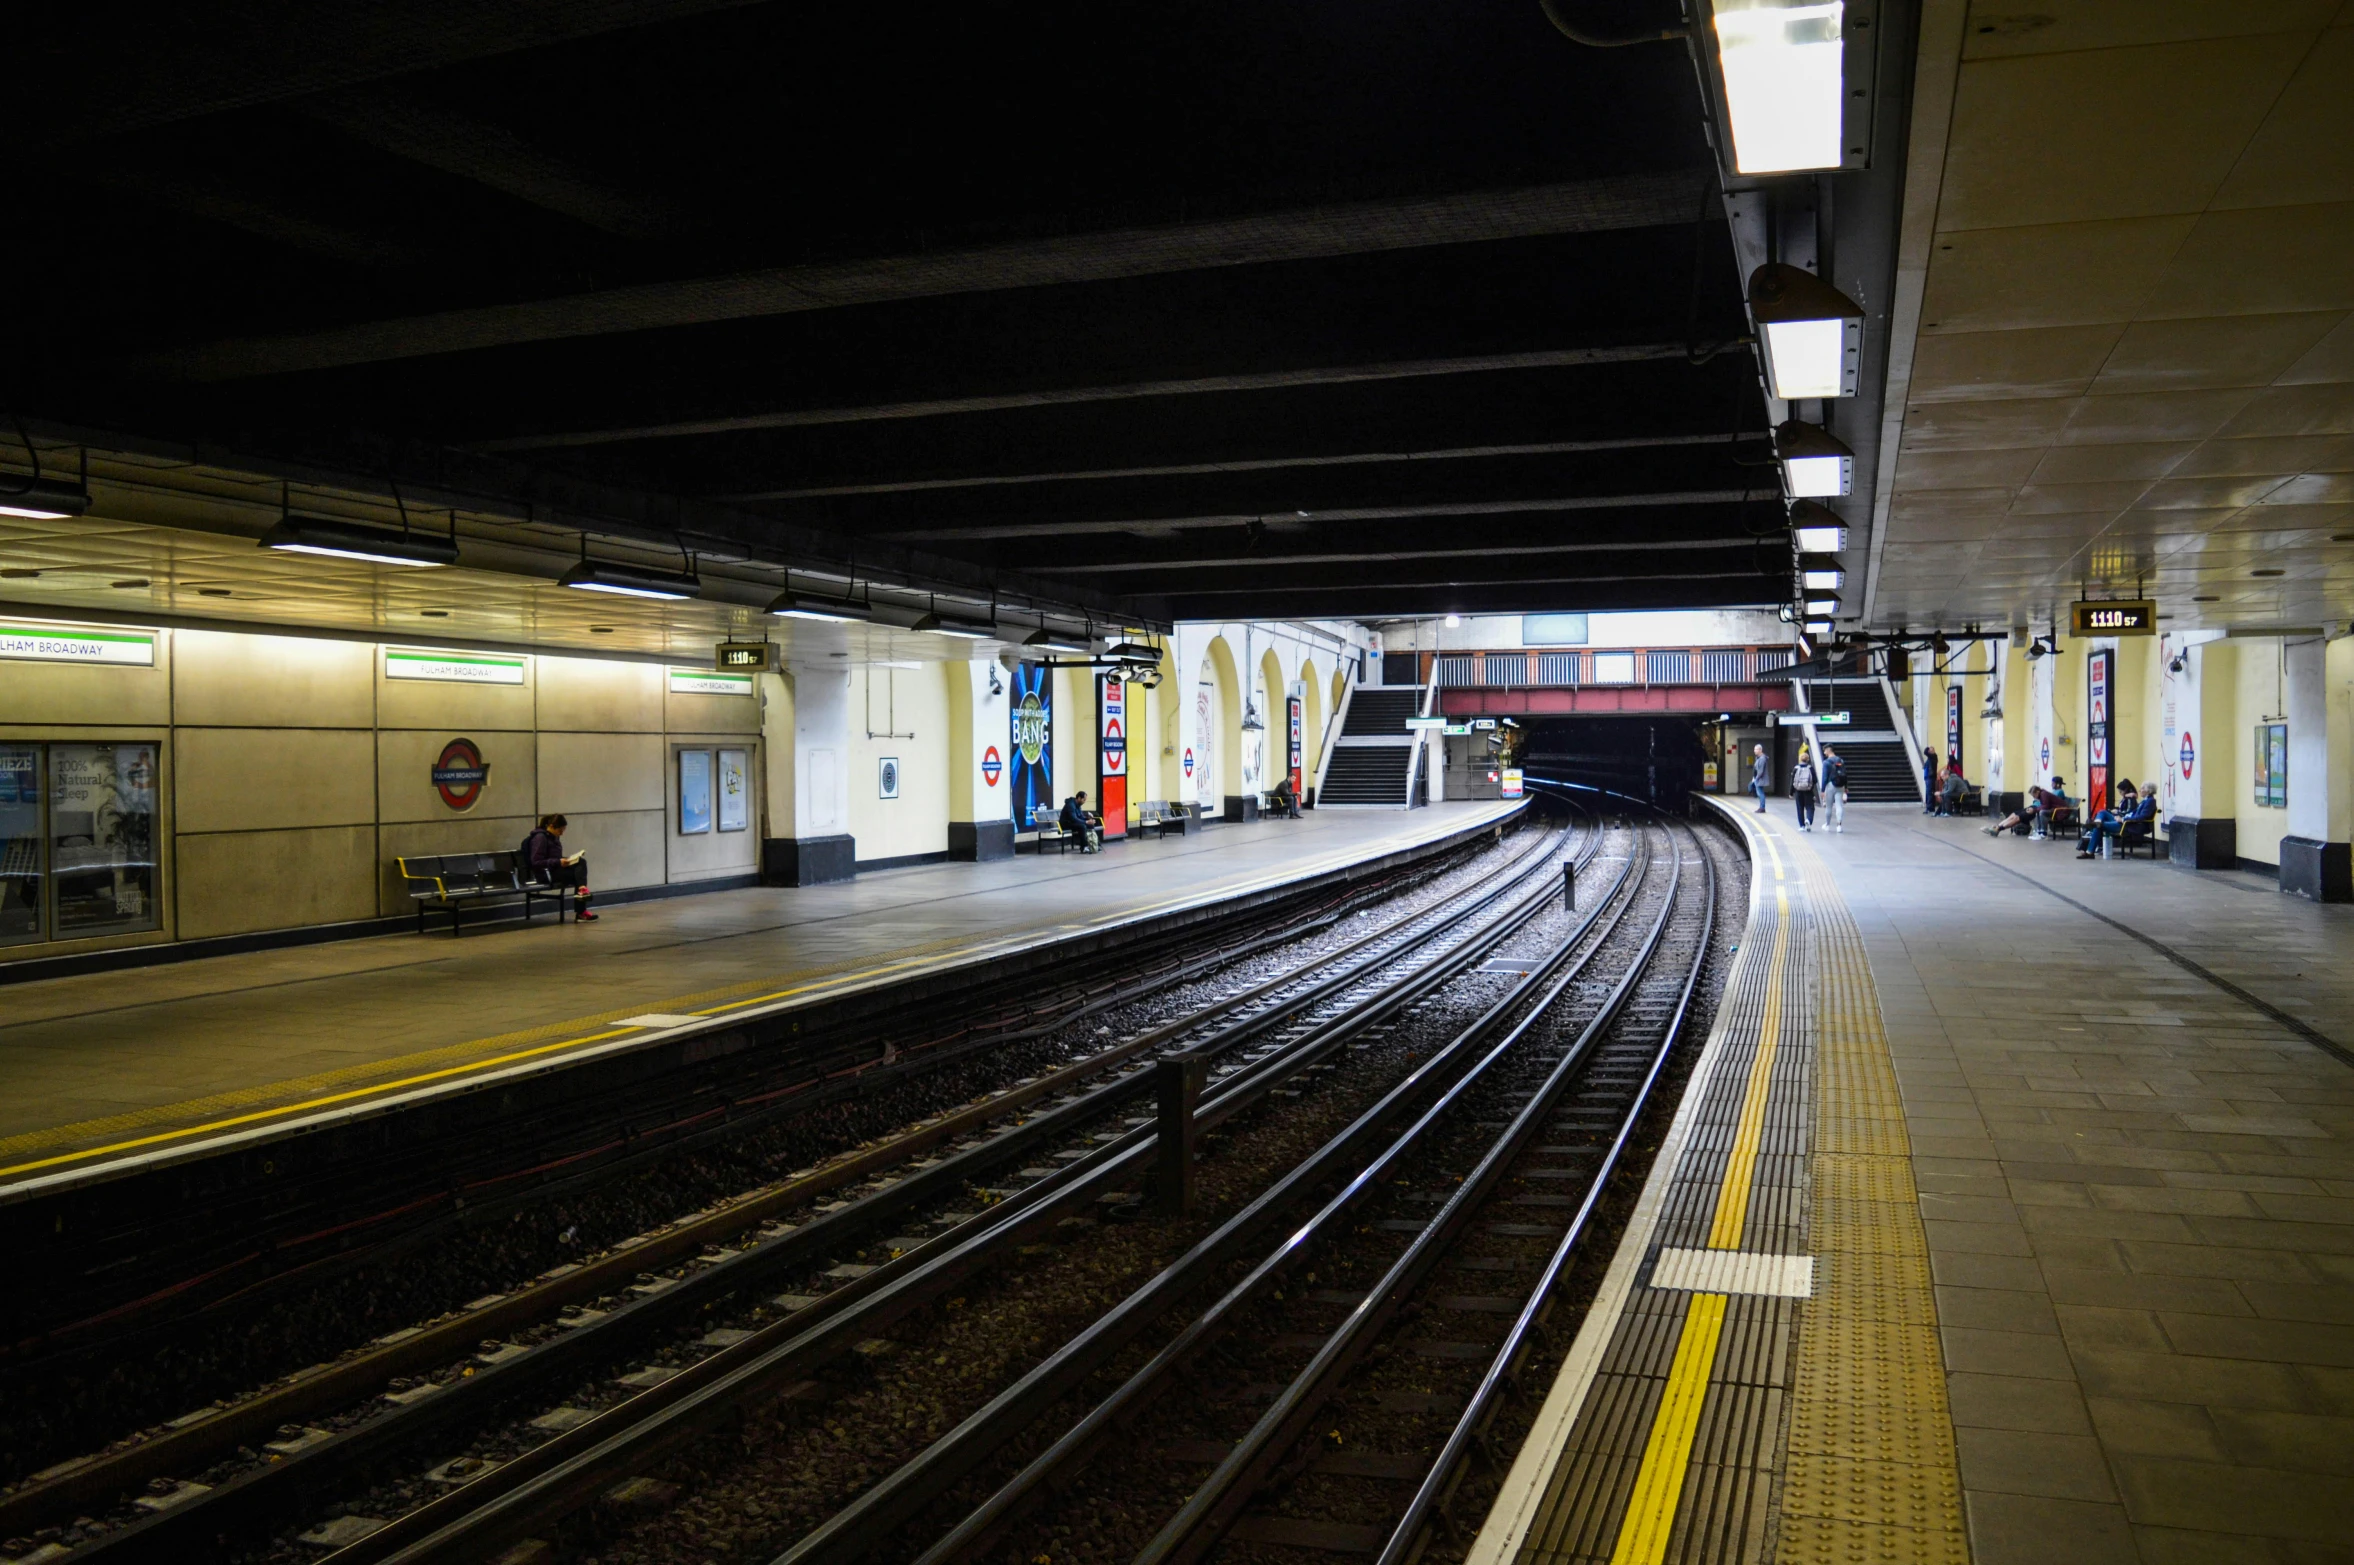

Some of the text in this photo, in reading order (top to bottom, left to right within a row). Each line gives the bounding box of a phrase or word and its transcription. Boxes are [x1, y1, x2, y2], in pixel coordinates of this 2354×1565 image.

[2090, 610, 2138, 627] 1110 57
[39, 641, 104, 655] BROADWAY
[727, 651, 749, 664] 1110
[421, 665, 492, 676] FULHAM BROADWAY
[1013, 719, 1049, 744] BANG
[58, 760, 88, 772] 100%
[58, 774, 102, 785] Natural
[58, 788, 89, 800] Sleep
